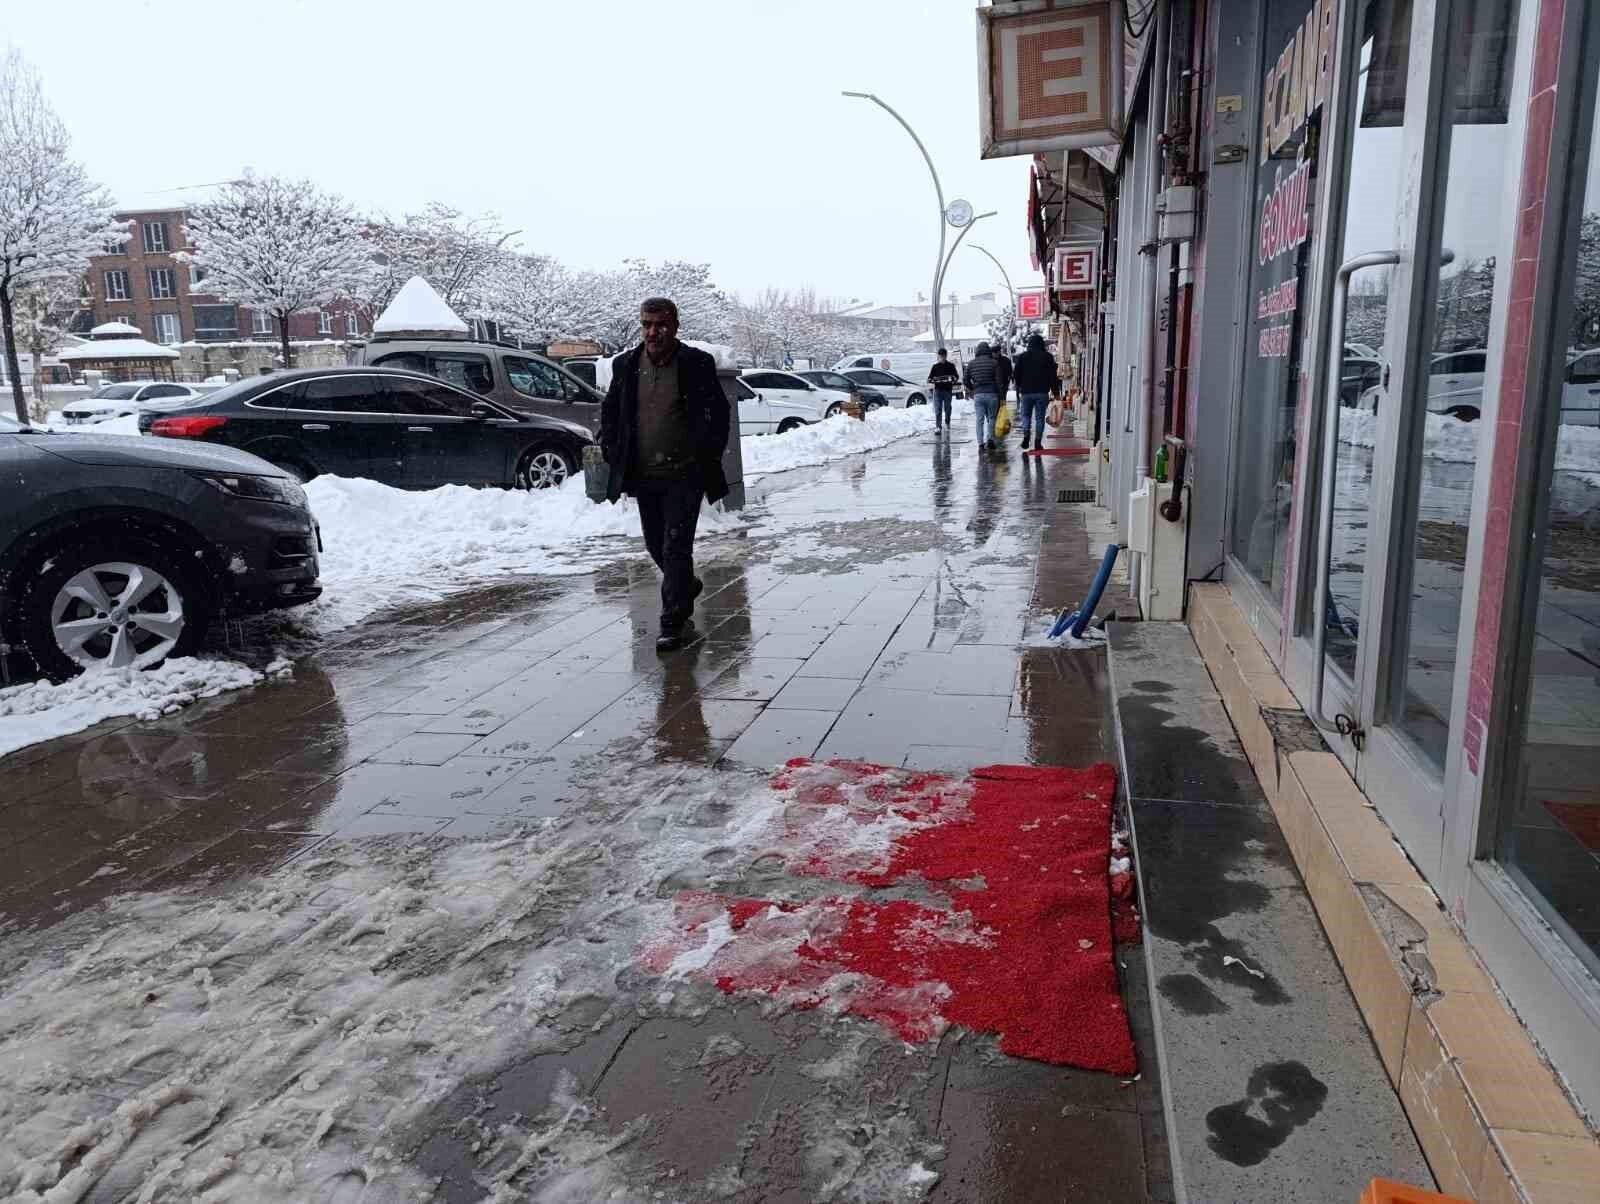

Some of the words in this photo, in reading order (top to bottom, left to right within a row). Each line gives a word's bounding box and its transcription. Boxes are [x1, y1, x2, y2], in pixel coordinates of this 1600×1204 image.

[1017, 27, 1088, 120] E
[1065, 257, 1085, 279] E
[1023, 298, 1039, 316] E
